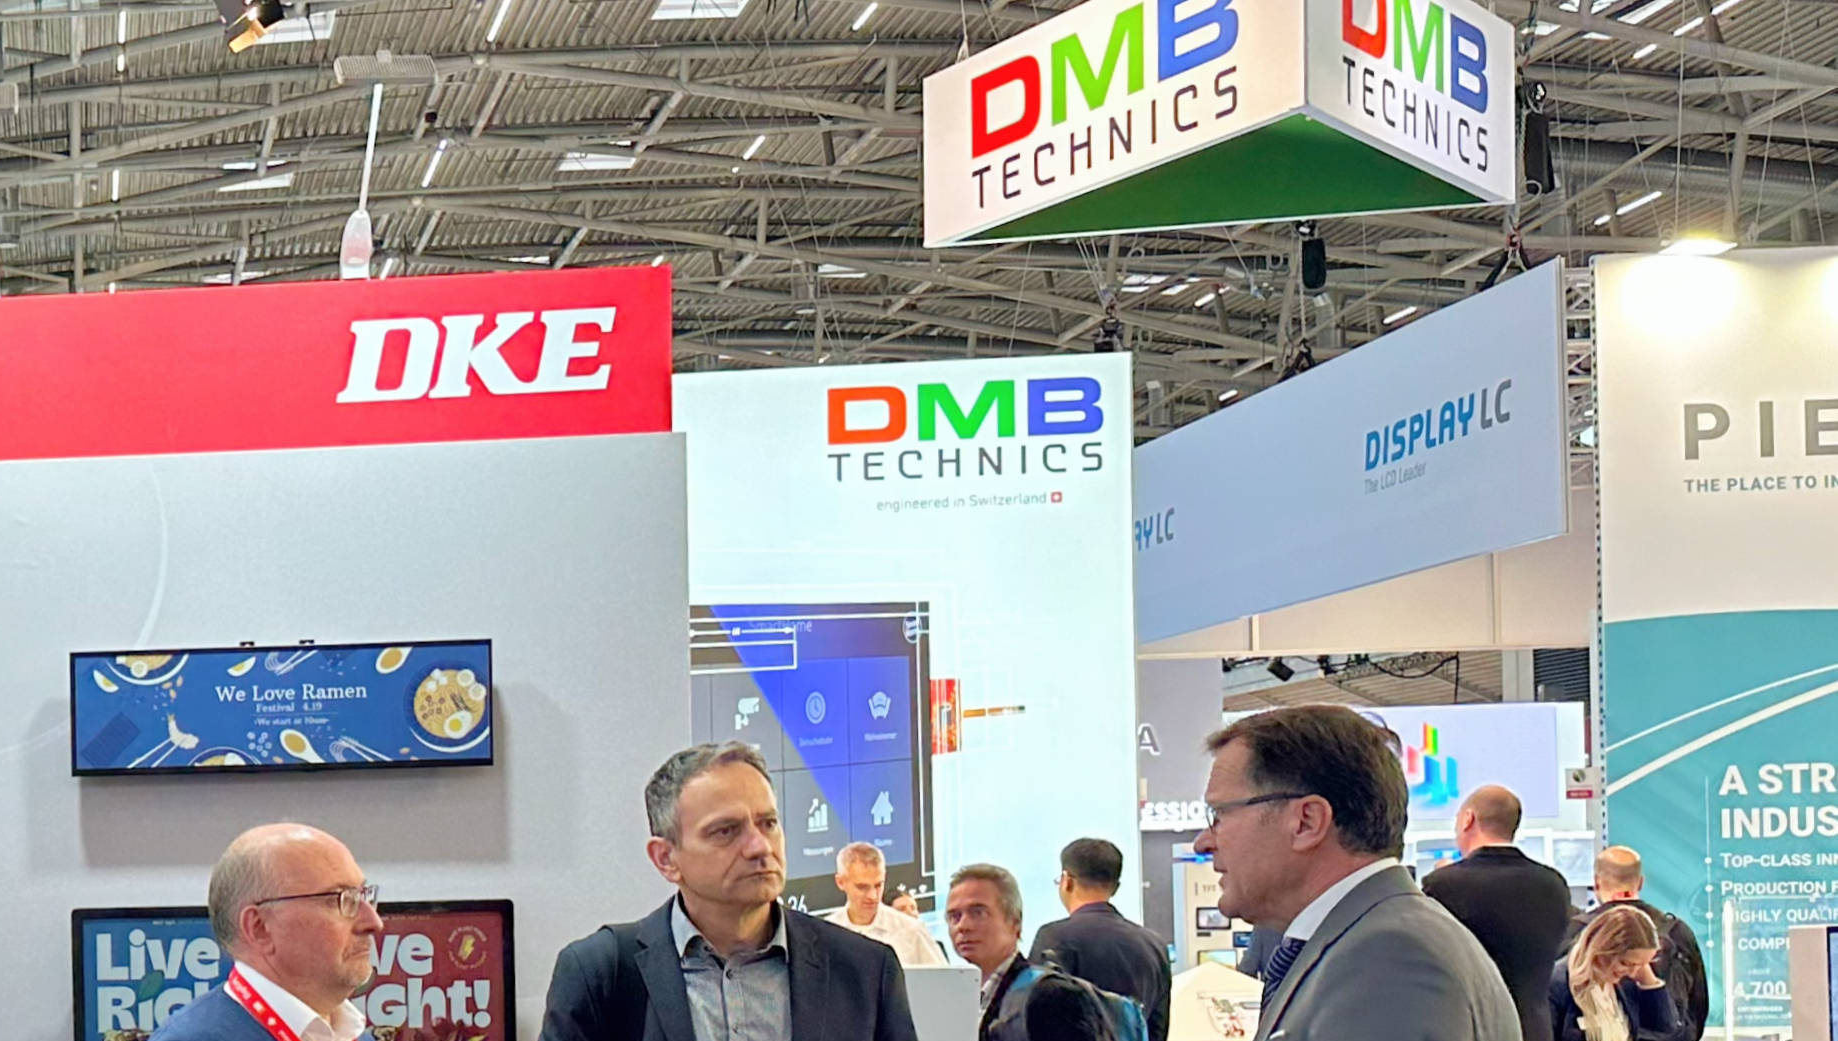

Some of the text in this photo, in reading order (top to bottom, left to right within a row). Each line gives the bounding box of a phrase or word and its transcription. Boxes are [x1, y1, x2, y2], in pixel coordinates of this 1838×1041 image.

[971, 0, 1239, 159] DMB
[1342, 55, 1489, 173] TECHNICS
[972, 65, 1239, 209] TECHNICS
[335, 306, 617, 404] DKE
[827, 377, 1104, 445] DMB
[827, 442, 1104, 482] TECHNICS
[1683, 477, 1721, 493] THE
[1726, 476, 1787, 492] PLACE
[1793, 475, 1818, 489] TO
[876, 492, 1048, 513] engineered in Switzerland
[215, 683, 368, 702] We Love Ramen
[256, 702, 295, 713] Festival
[1718, 762, 1837, 796] A STR
[1720, 805, 1838, 839] INDUS
[1719, 852, 1812, 868] TOP-CLASS
[1720, 880, 1827, 895] PRODUCTION
[1735, 907, 1782, 924] IGHLY
[96, 928, 221, 981] Live
[368, 932, 435, 976] ve
